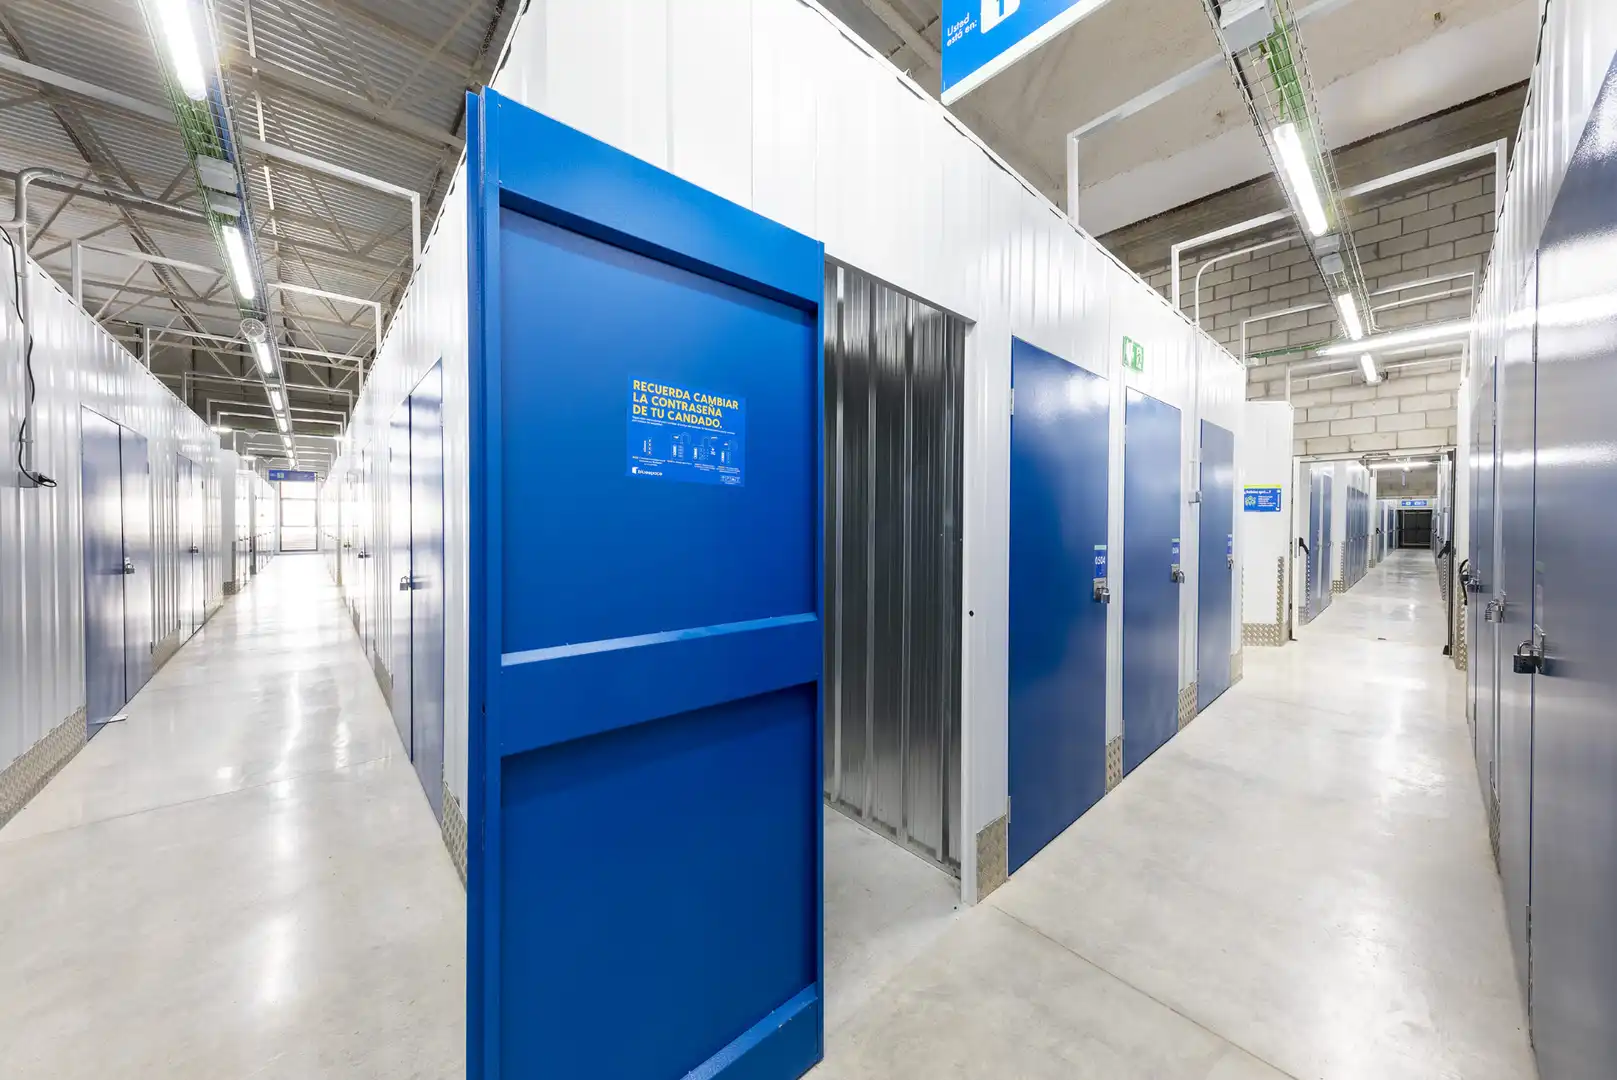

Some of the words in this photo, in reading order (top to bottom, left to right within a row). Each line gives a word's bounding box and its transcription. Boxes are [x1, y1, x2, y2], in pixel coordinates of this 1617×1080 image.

[946, 29, 963, 47] está
[965, 20, 978, 33] en:
[947, 12, 970, 37] Usted
[633, 379, 691, 400] RECUERDA
[693, 392, 739, 410] CAMBIAR
[633, 392, 648, 404] LA
[651, 395, 723, 417] CONTRASEÑA
[633, 404, 648, 416] DE
[651, 407, 665, 418] TU
[667, 410, 723, 428] CANDADO.
